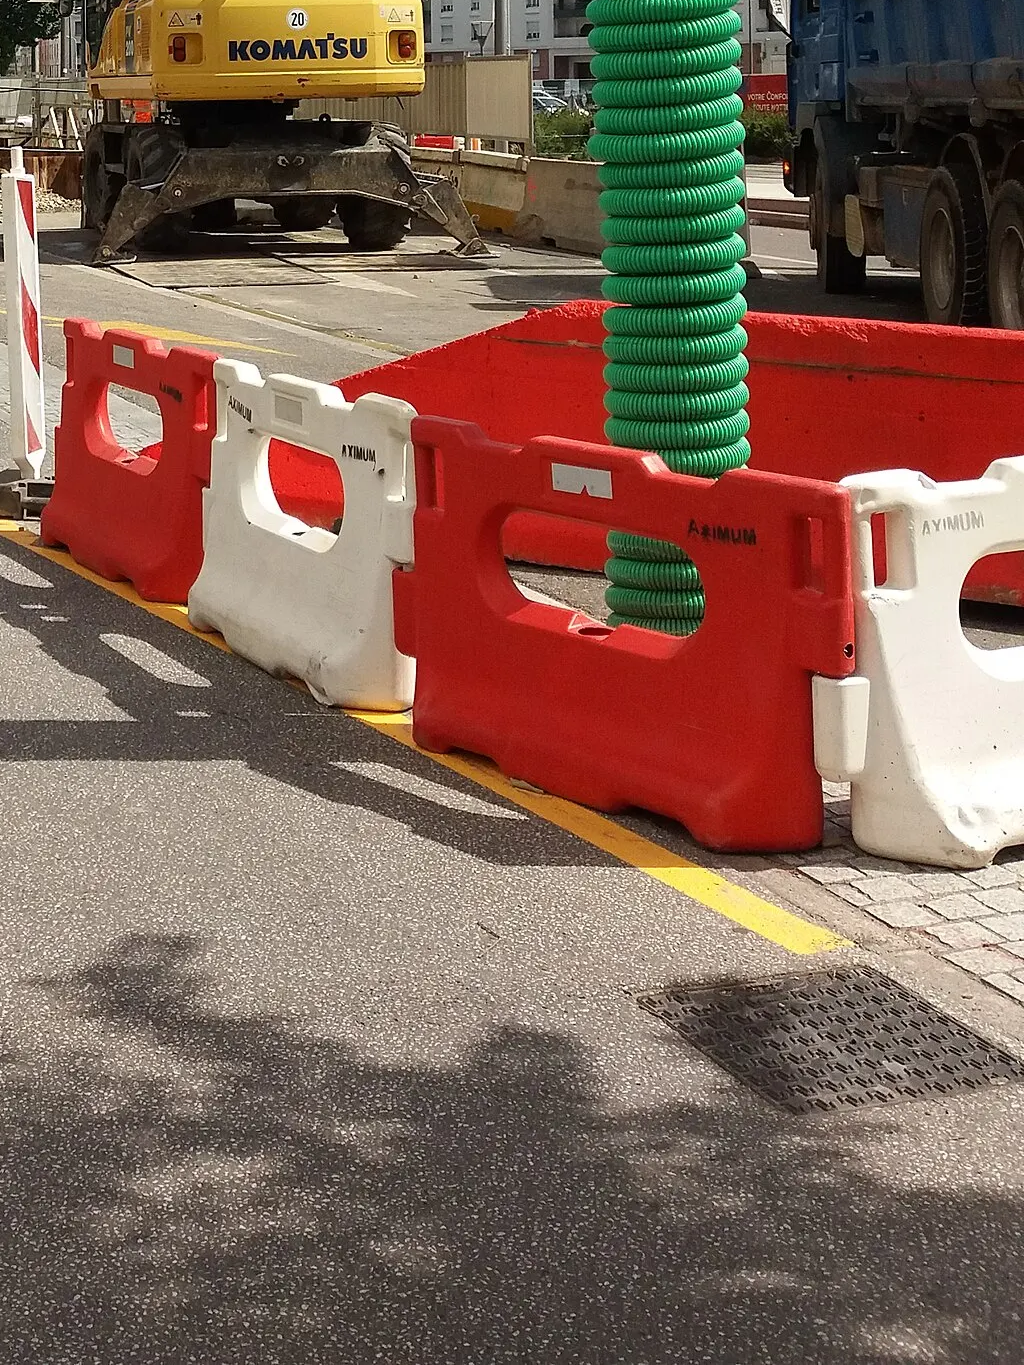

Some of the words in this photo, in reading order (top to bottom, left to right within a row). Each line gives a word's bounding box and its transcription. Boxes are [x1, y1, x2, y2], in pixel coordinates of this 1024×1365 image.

[291, 12, 305, 27] 20
[228, 33, 368, 62] KOMATSU
[747, 93, 765, 101] VOTRE
[766, 91, 789, 101] CONFO
[228, 395, 252, 423] AXIMUM
[342, 444, 376, 463] AXIMUM
